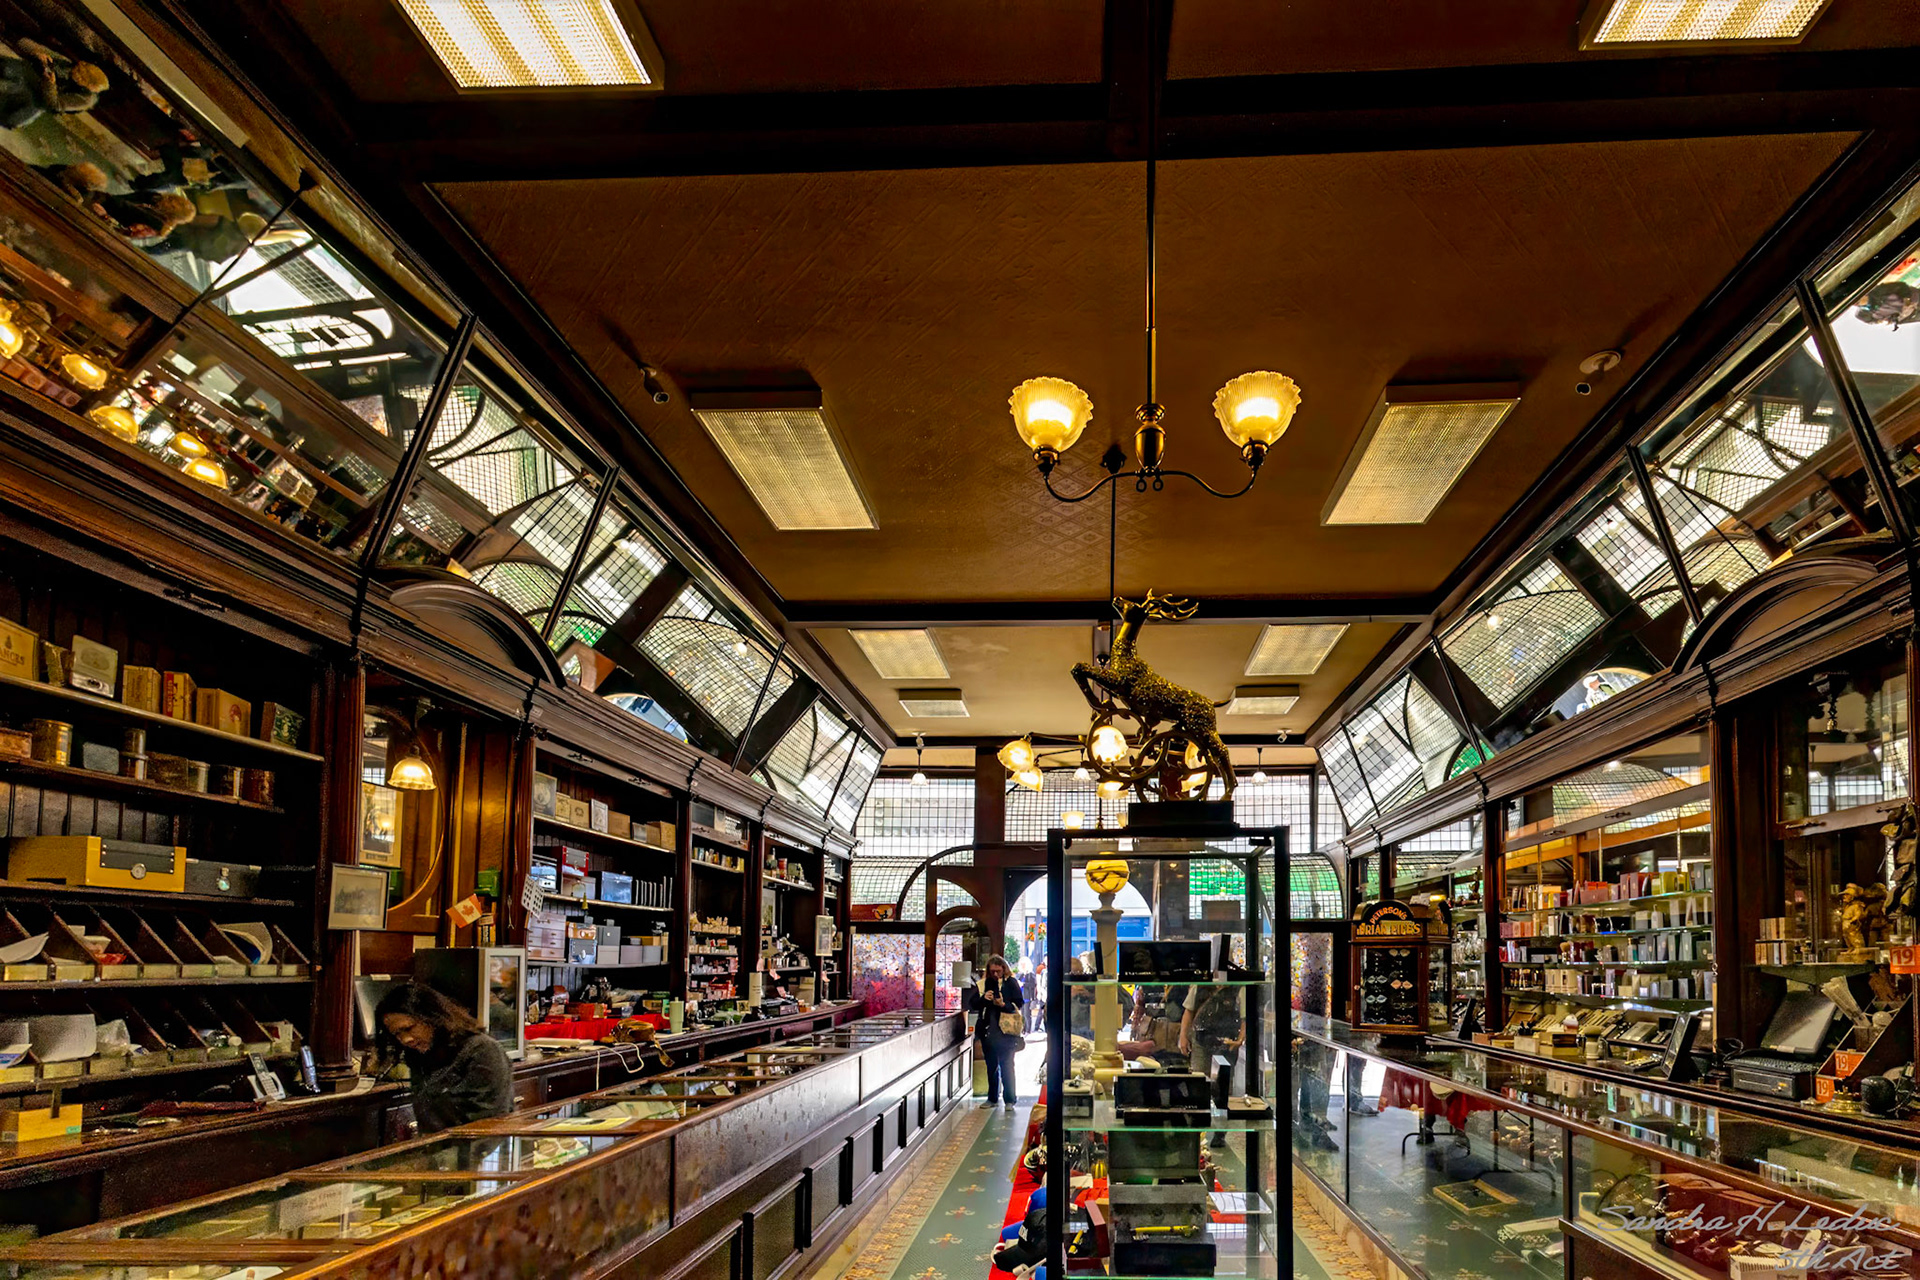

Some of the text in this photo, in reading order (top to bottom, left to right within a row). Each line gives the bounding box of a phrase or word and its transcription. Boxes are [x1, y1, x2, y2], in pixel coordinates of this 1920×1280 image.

[1369, 906, 1408, 925] PETERSON'S
[1893, 949, 1914, 965] 19
[1836, 1055, 1847, 1070] 19
[1817, 1081, 1828, 1096] 19
